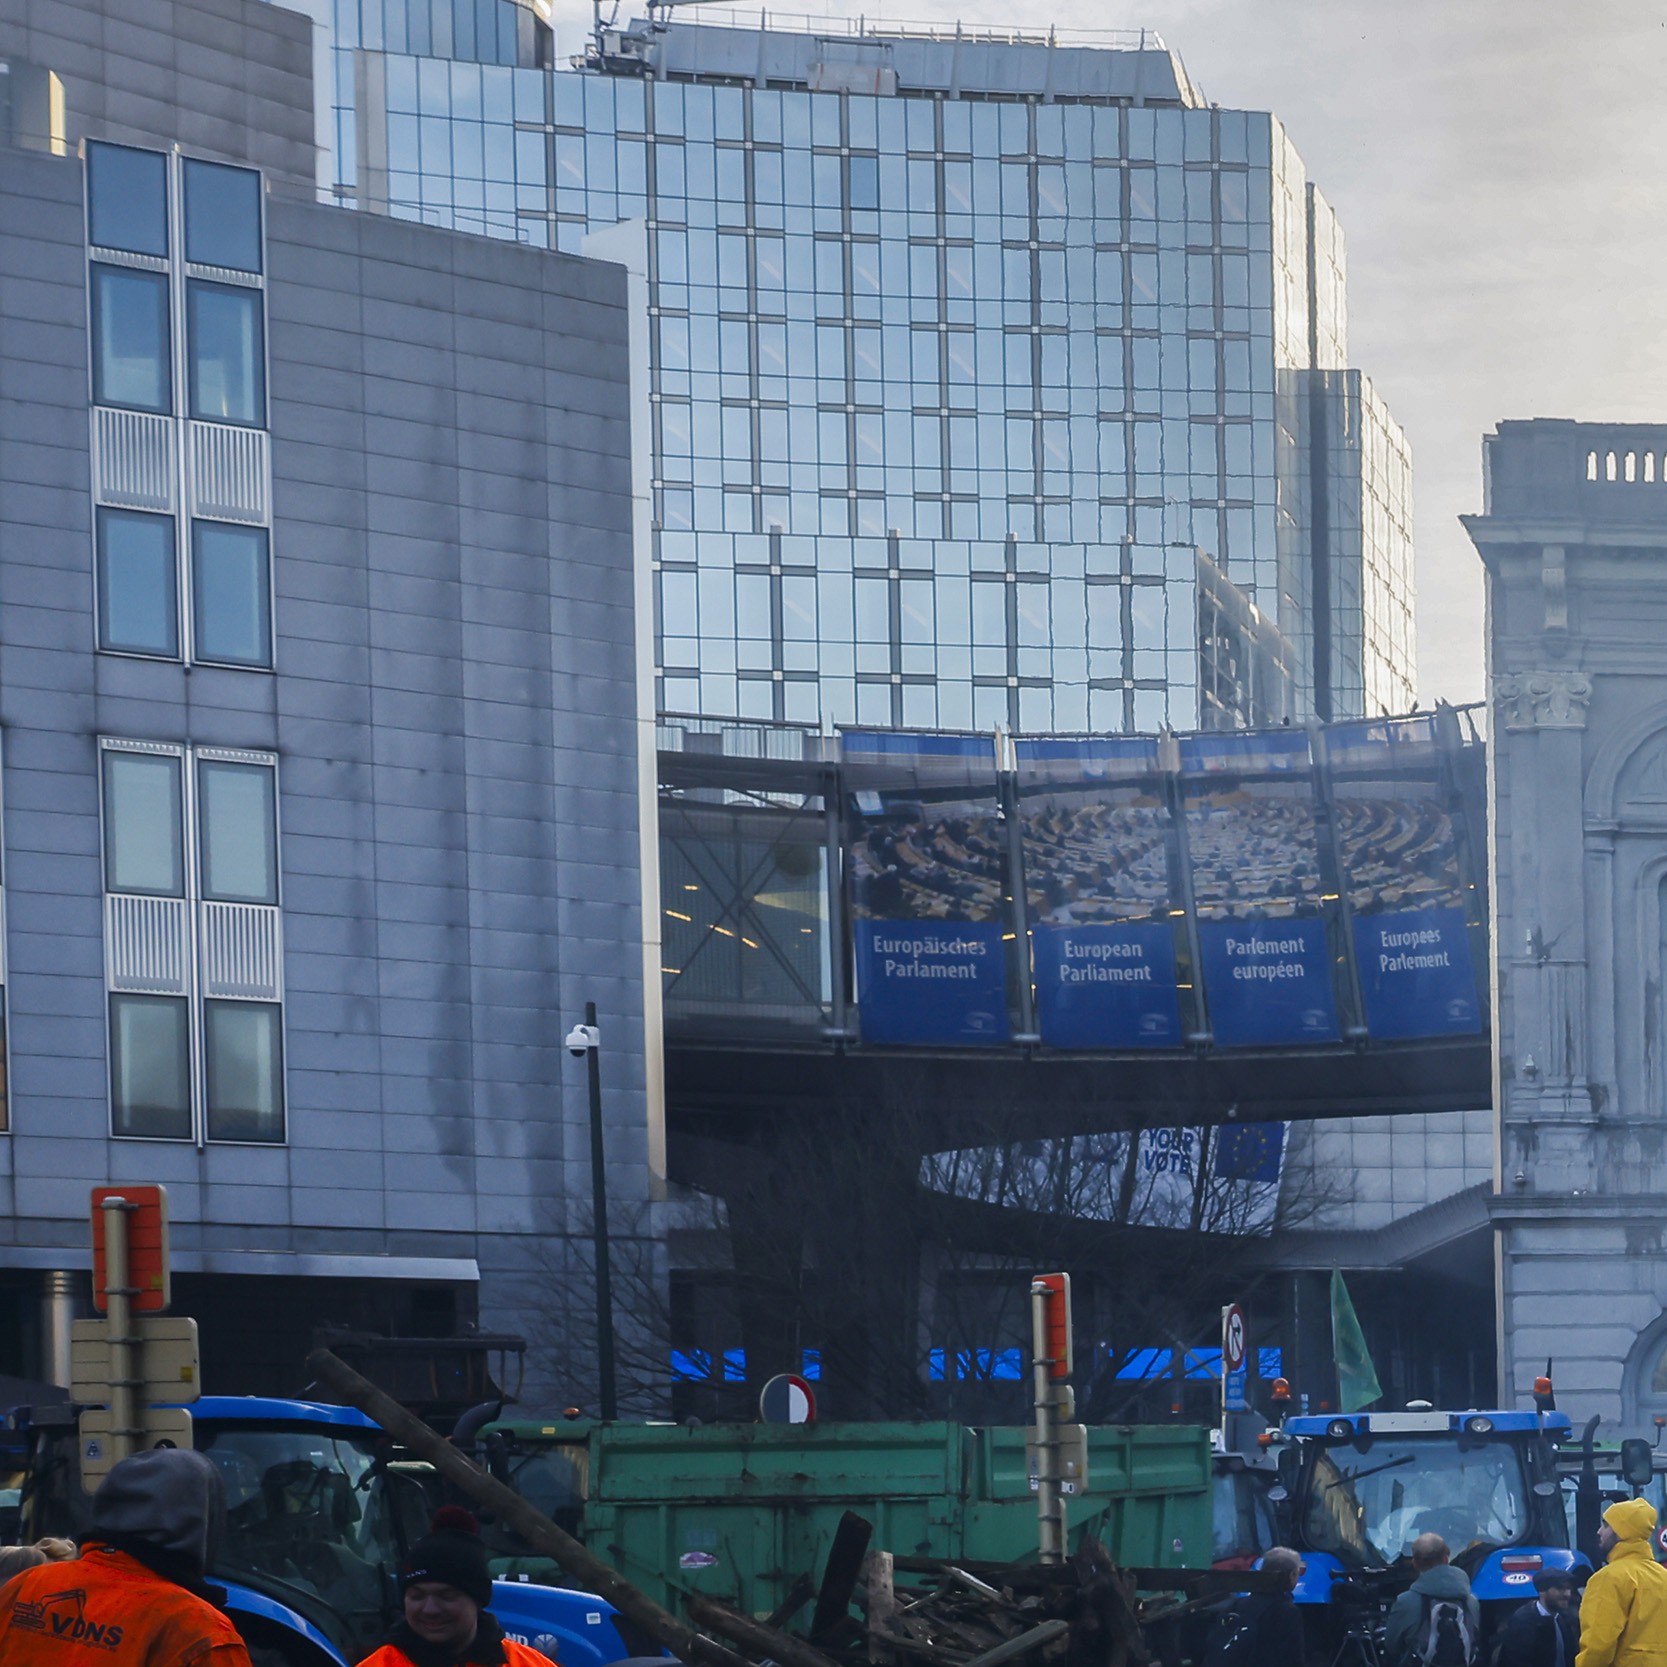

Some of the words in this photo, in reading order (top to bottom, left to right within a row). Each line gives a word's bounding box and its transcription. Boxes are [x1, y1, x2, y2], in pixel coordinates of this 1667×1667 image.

[873, 935, 986, 957] Europäisches
[1226, 937, 1305, 955] Parlement
[1380, 928, 1440, 949] Europees
[1064, 940, 1142, 961] European
[885, 960, 977, 979] Parlament
[1233, 960, 1304, 982] européen
[1379, 951, 1450, 972] Parlement
[1060, 964, 1151, 982] Parliament
[1149, 1128, 1194, 1152] YOUR
[1143, 1150, 1191, 1174] VOTE
